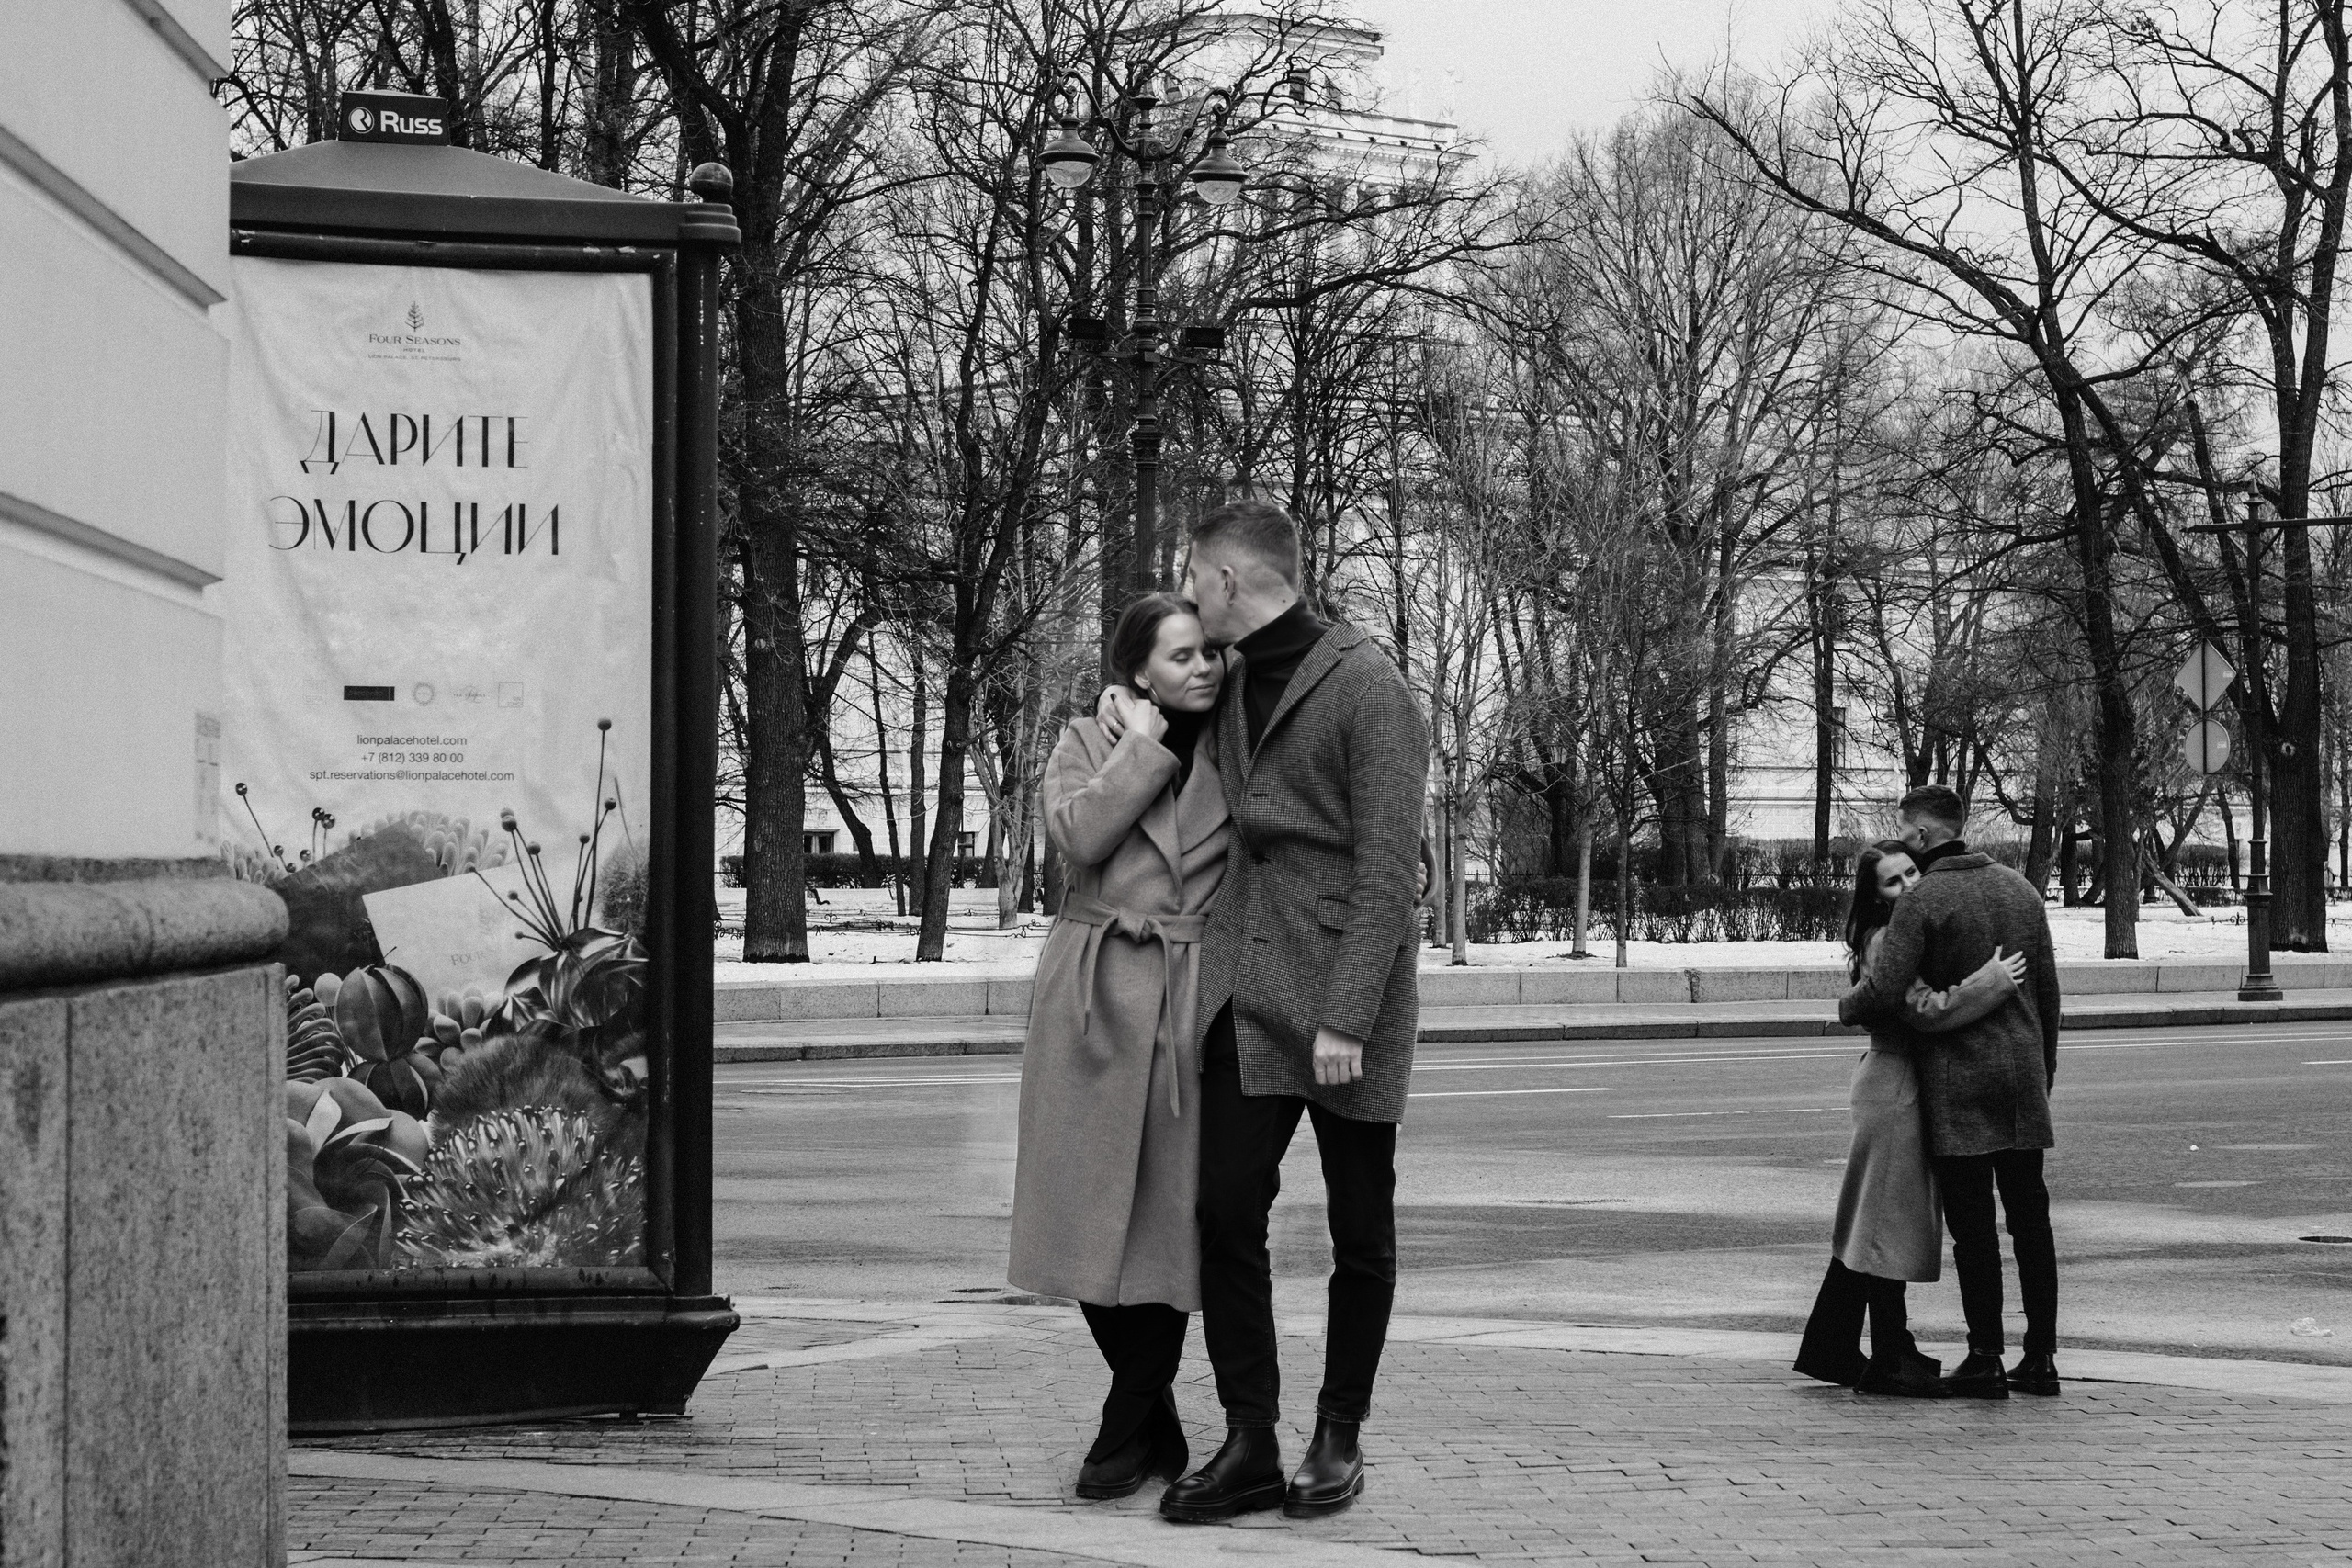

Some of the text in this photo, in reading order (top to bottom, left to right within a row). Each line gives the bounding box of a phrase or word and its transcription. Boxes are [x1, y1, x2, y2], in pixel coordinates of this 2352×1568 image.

[380, 110, 443, 135] Russ
[369, 333, 461, 346] FOUR SEASONS
[300, 409, 529, 475] ДАРИТЕ
[268, 495, 559, 565] ЭМОЦИИ
[356, 735, 468, 747] lionpalacehotel.com
[361, 752, 464, 764] +7 (812) 339 80 00
[309, 770, 514, 782] spt.reservations@lionpalacehotel.com
